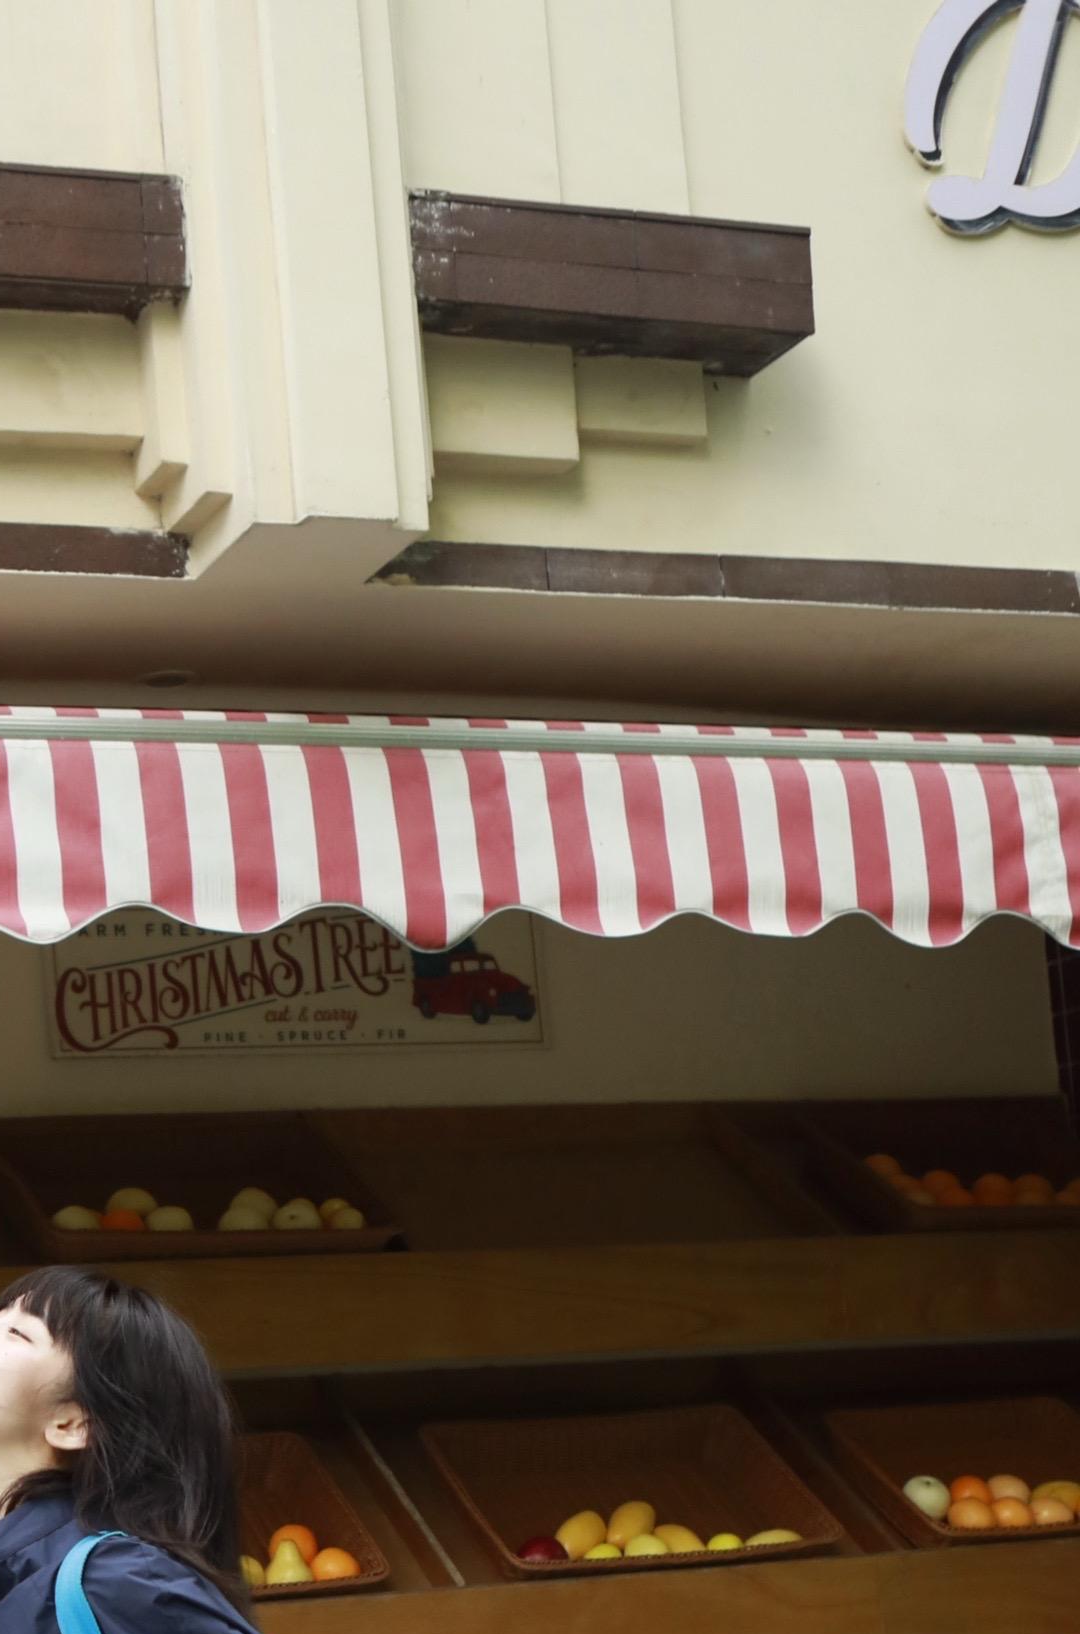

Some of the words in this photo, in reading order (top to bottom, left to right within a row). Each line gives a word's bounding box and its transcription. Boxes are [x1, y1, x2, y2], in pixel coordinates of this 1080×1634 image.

[54, 931, 304, 1052] CHRISTMAS
[298, 917, 407, 996] TREE
[298, 1005, 309, 1024] &
[312, 1006, 360, 1031] carry
[203, 1031, 248, 1043] PINE
[277, 1029, 348, 1042] SPRUCE
[376, 1028, 407, 1041] FIR
